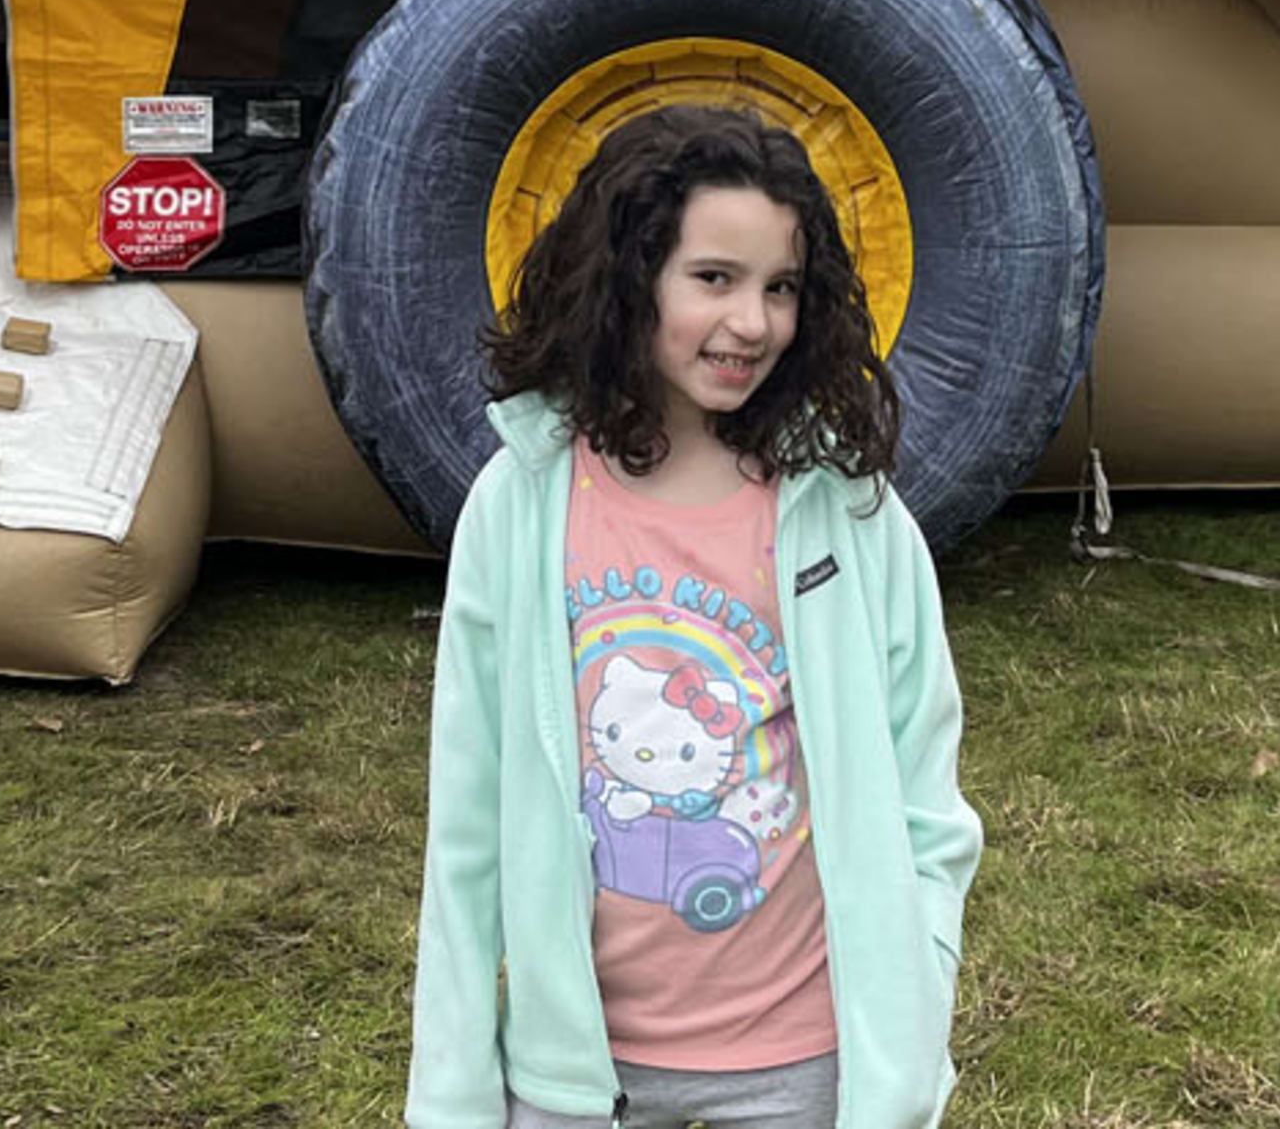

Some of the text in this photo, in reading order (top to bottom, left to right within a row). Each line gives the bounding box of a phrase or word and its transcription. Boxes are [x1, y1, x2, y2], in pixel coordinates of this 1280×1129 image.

[109, 186, 214, 216] STOP!
[138, 220, 162, 230] NOT
[564, 566, 662, 621] ELLO
